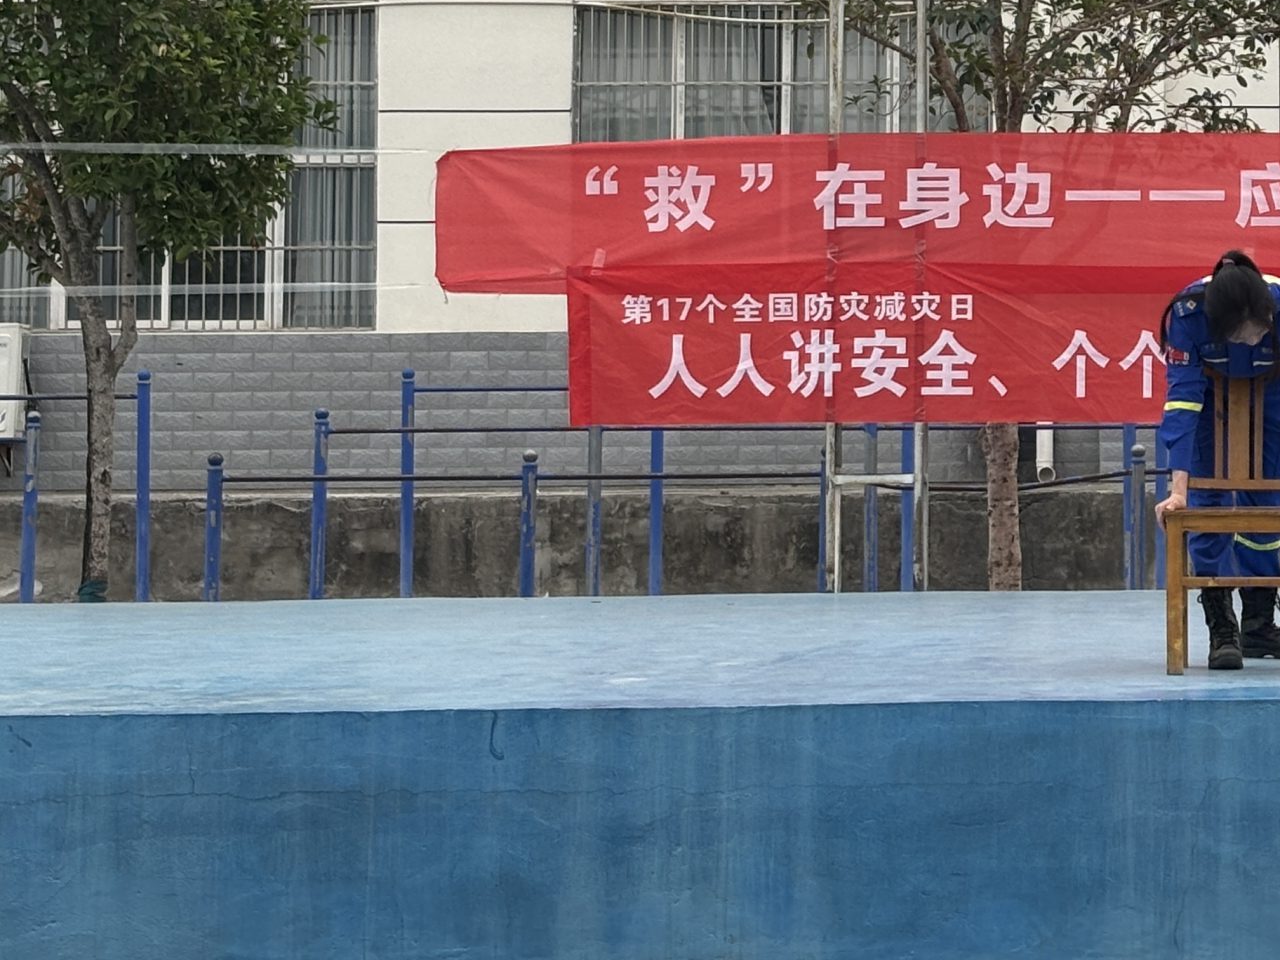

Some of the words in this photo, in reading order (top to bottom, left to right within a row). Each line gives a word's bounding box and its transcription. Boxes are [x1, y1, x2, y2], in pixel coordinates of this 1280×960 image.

[621, 291, 975, 325] 第17个全国防灾减灾日
